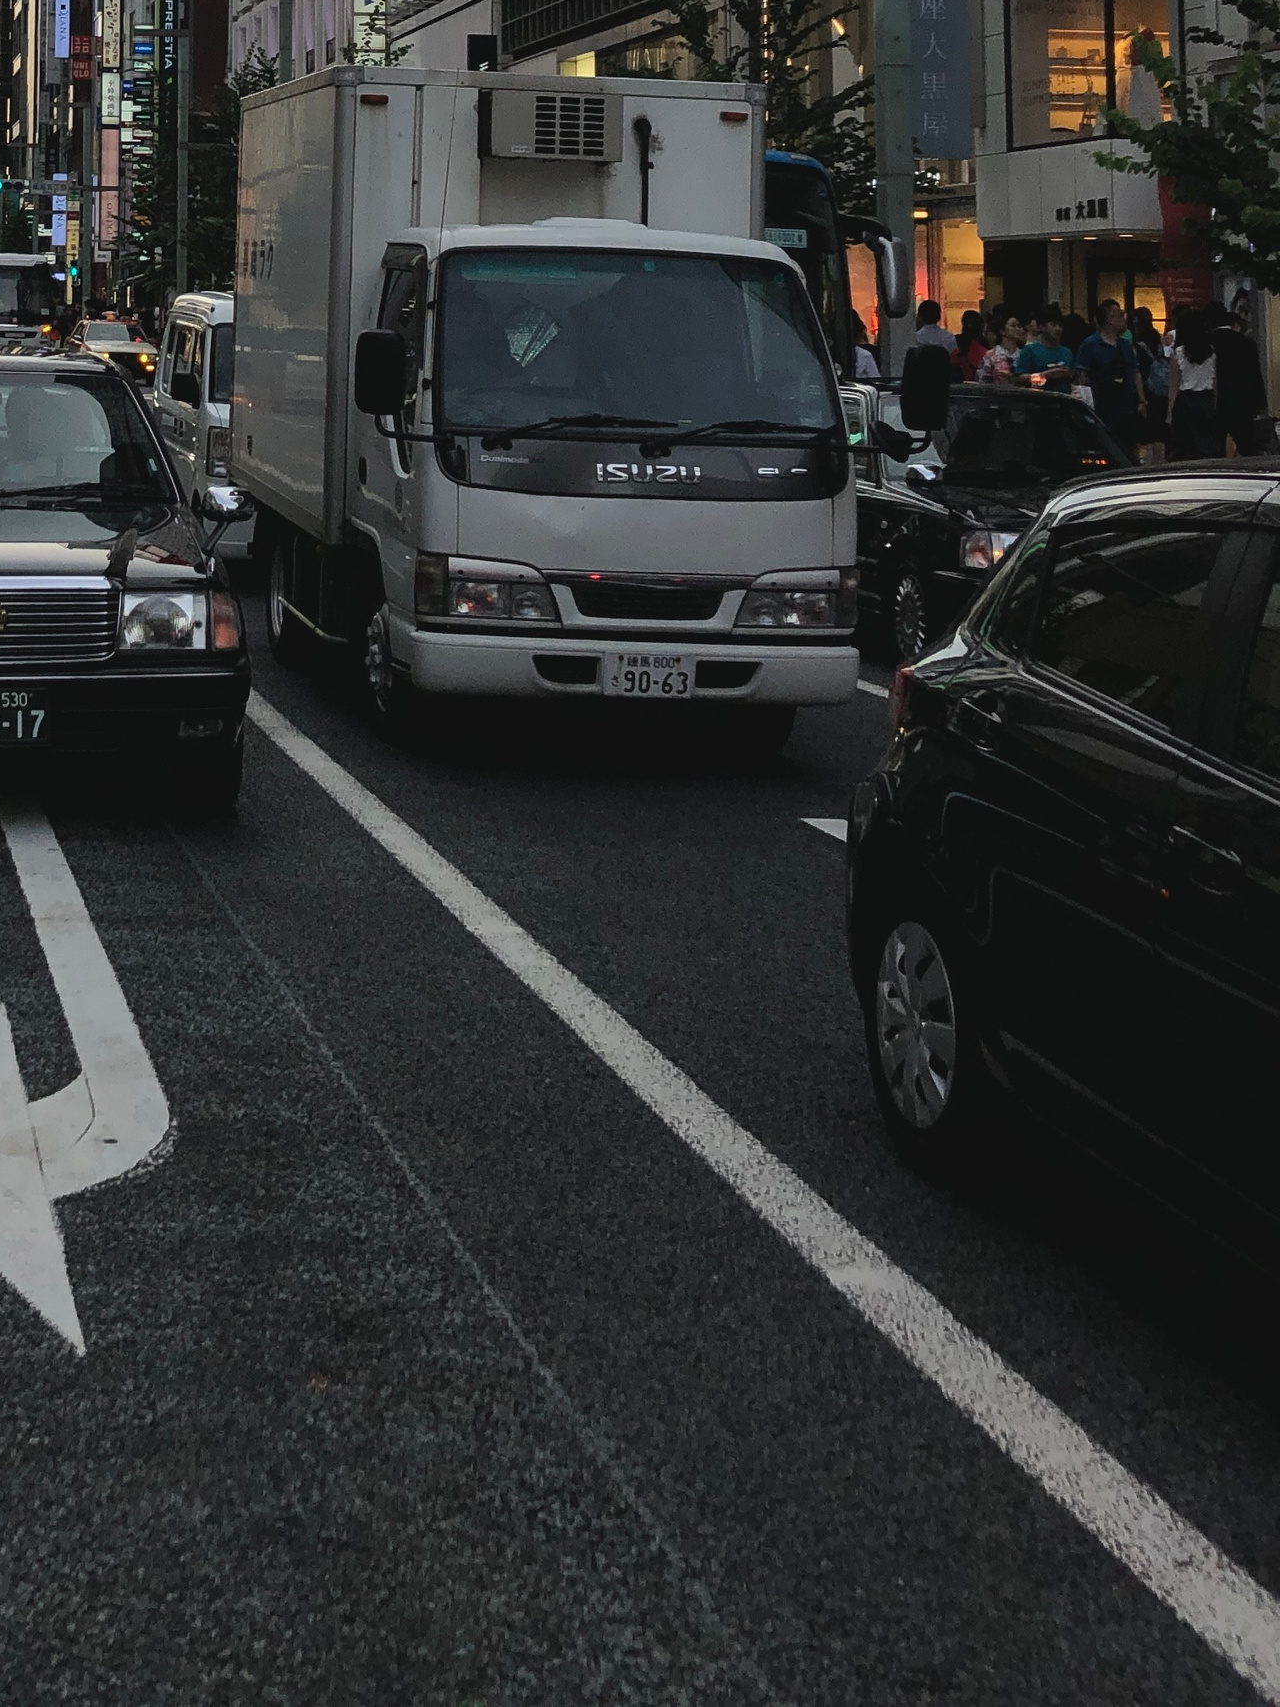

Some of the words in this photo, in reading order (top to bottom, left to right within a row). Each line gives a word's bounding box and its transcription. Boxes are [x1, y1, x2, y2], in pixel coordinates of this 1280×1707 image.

[74, 70, 89, 78] QLO
[597, 462, 701, 484] ISUZU
[653, 657, 675, 668] 800
[624, 670, 689, 694] 90-63
[1, 692, 28, 707] 530
